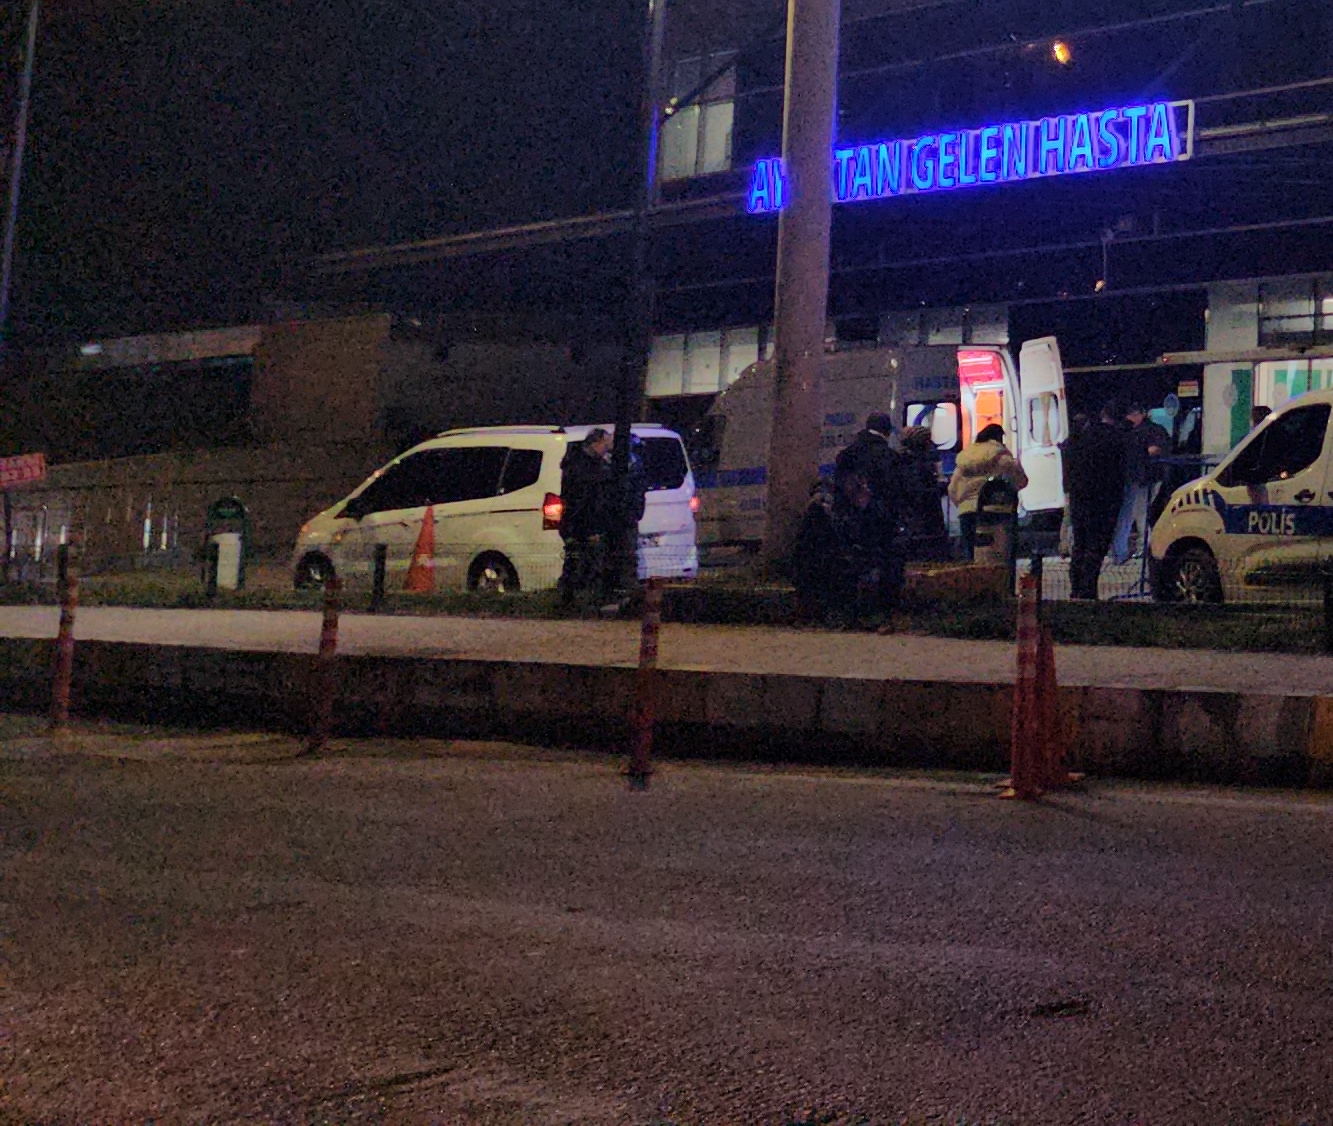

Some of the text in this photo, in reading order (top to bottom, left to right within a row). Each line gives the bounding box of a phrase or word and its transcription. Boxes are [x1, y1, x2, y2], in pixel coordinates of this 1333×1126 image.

[749, 103, 1172, 210] AYTAN GELEN HASTA
[1248, 507, 1297, 536] POLİS
